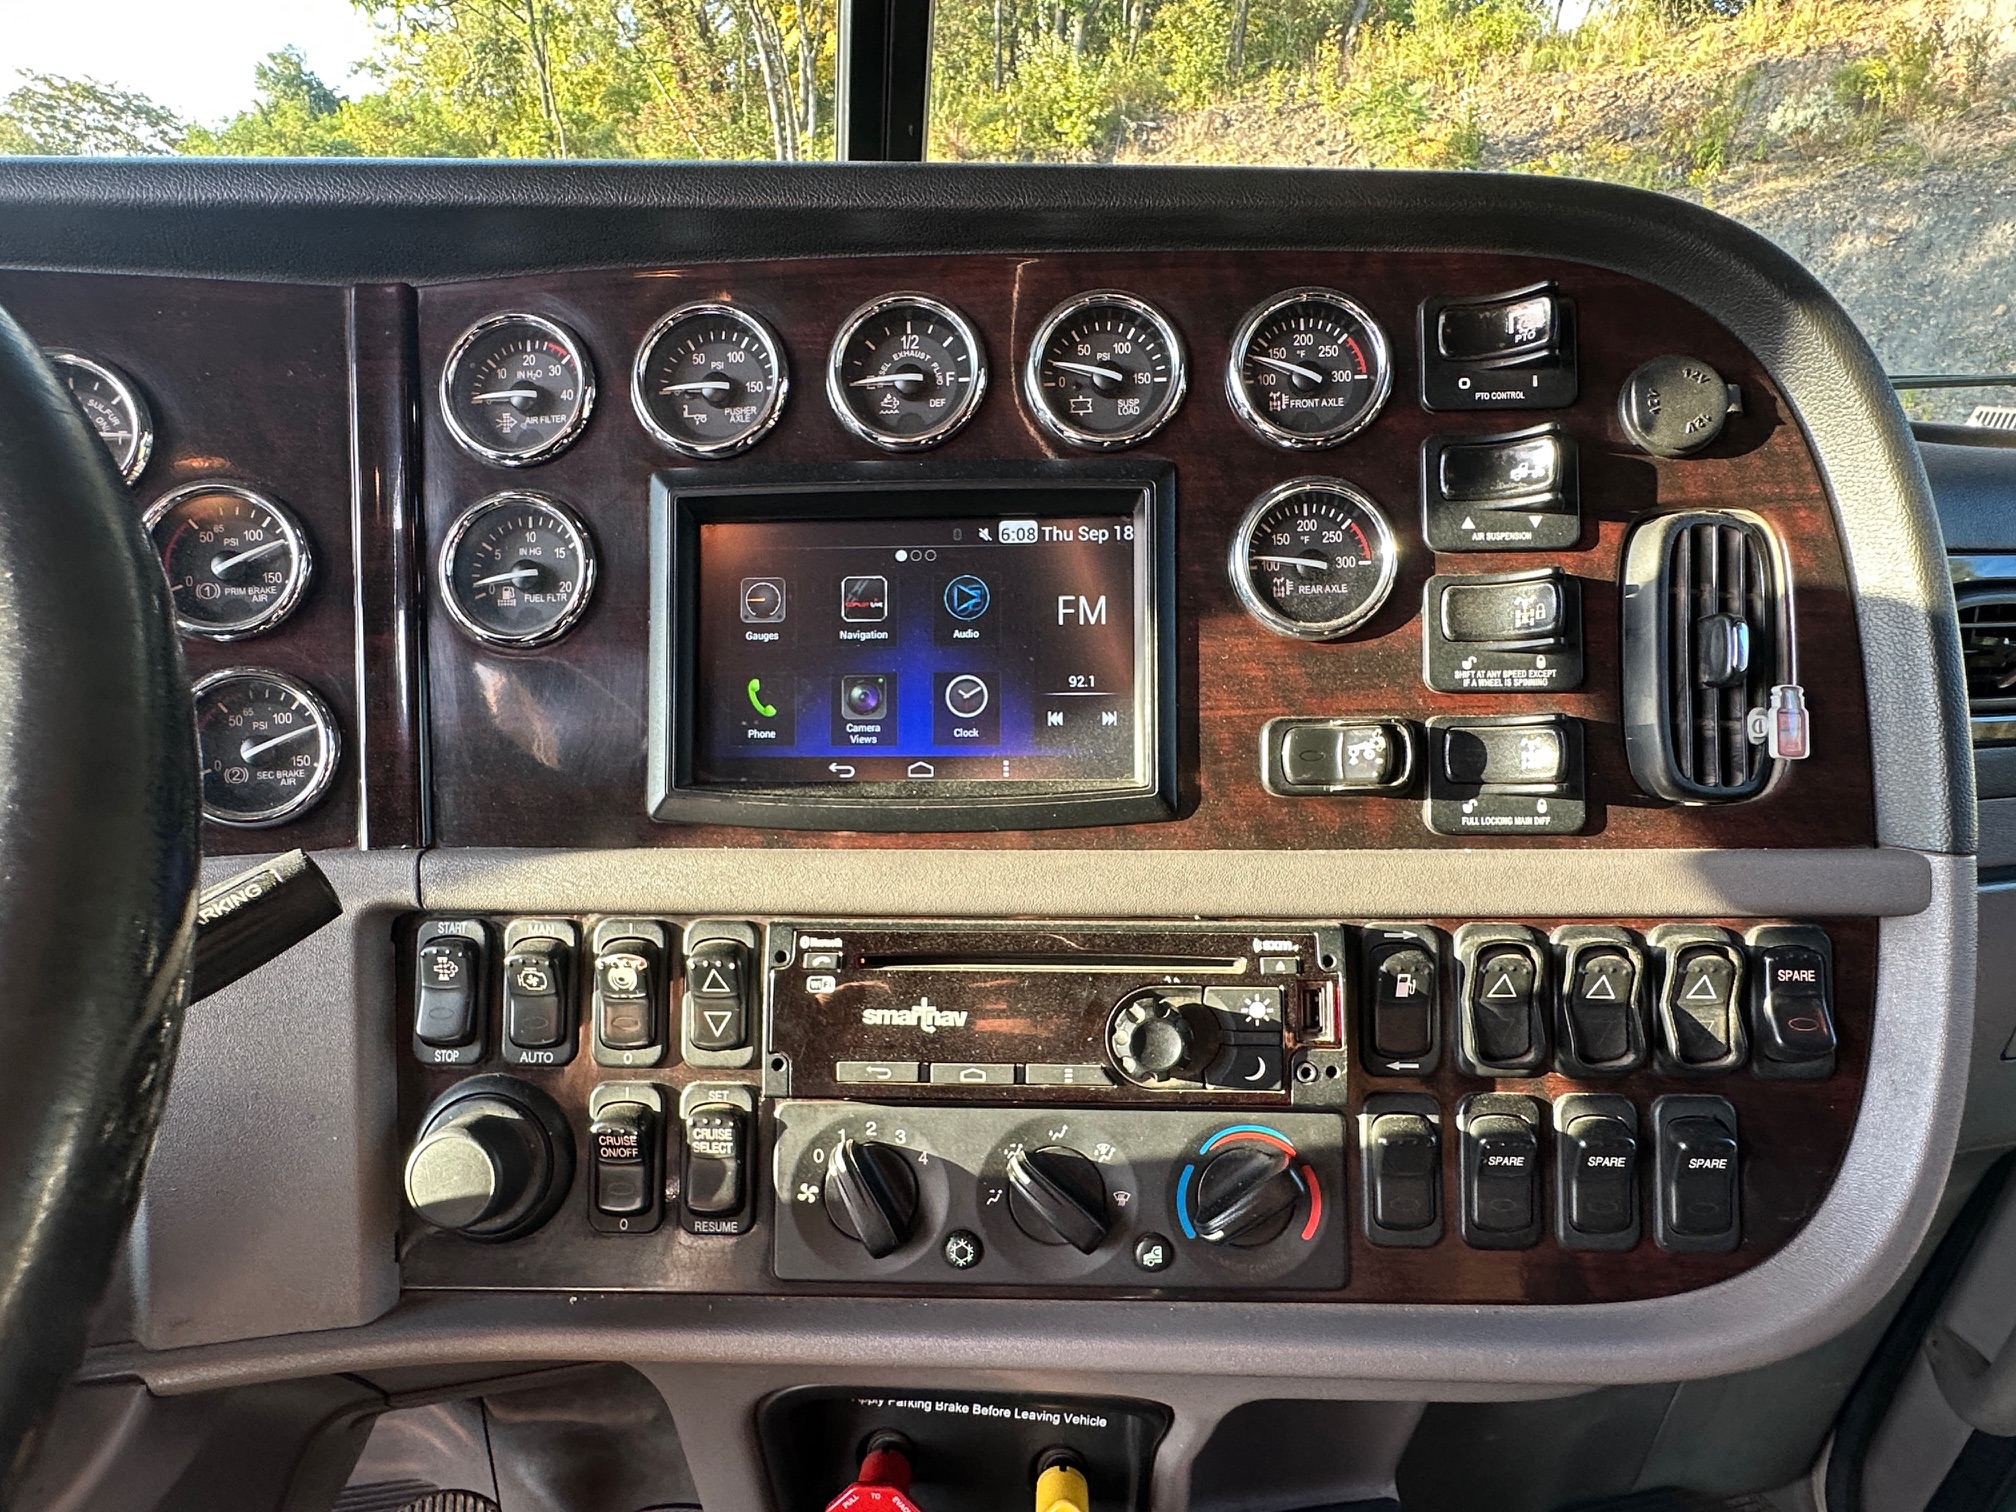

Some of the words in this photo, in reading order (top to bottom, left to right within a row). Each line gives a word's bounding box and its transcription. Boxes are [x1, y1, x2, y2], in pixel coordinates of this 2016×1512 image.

[1294, 334, 1313, 346] 200
[1515, 331, 1535, 342] PTO
[901, 335, 919, 349] 1/2
[1078, 344, 1090, 355] 50
[1113, 342, 1131, 354] 100
[1319, 346, 1338, 357] 250
[727, 352, 745, 362] 100
[892, 351, 931, 362] EXHAUST
[1268, 348, 1286, 359] 150
[523, 355, 535, 366] 20
[692, 354, 705, 364] 50
[549, 365, 561, 376] 30
[711, 362, 724, 370] PSI
[497, 369, 506, 379] 10
[517, 371, 526, 379] IN
[946, 372, 955, 386] F
[1133, 373, 1150, 384] 150
[1332, 371, 1351, 382] 300
[1059, 377, 1065, 387] 0
[1258, 374, 1276, 386] 100
[746, 382, 763, 392] 150
[561, 390, 573, 400] 40
[1476, 392, 1490, 400] PTO
[1492, 391, 1525, 399] CONTROL
[930, 399, 945, 407] DEF
[1118, 399, 1139, 407] SUSP
[1290, 399, 1319, 408] FRONT
[1321, 398, 1344, 406] AXLE
[88, 399, 120, 426] SULFUR
[725, 406, 756, 414] PUSHER
[1118, 406, 1140, 415] LOAD
[540, 415, 566, 423] FILTER
[729, 414, 750, 422] AXLE
[1297, 519, 1317, 531] 200
[200, 531, 213, 542] 50
[244, 530, 262, 542] 100
[526, 532, 536, 542] 10
[1001, 530, 1036, 540] 6:08
[1042, 527, 1073, 541] Thu
[1078, 527, 1109, 544] Sep
[1114, 526, 1134, 540] 18
[1272, 534, 1290, 544] 150
[1322, 531, 1342, 543] 250
[1472, 532, 1484, 540] AIR
[1486, 532, 1531, 540] SUSPENSION
[224, 538, 238, 546] PSI
[495, 550, 501, 560] 5
[529, 547, 541, 555] HG
[554, 548, 565, 558] 15
[1262, 562, 1280, 571] 100
[1336, 556, 1355, 568] 300
[185, 576, 193, 586] 0
[262, 572, 282, 583] 150
[248, 586, 276, 594] BRAKE
[489, 584, 495, 594] 0
[559, 582, 571, 592] 20
[1299, 585, 1322, 594] REAR
[1325, 584, 1347, 593] AXLE
[525, 594, 545, 602] FUEL
[547, 594, 567, 602] FLTR
[1058, 595, 1106, 625] FM
[746, 631, 779, 642] Gauges
[840, 630, 888, 641] Navigation
[953, 630, 979, 639] Audio
[1454, 670, 1476, 678] SHIFT
[1477, 670, 1486, 678] AT
[1486, 670, 1502, 678] ANY
[1503, 670, 1527, 678] SPEED
[1529, 669, 1557, 678] EXCEPT
[1069, 676, 1095, 687] 92.1
[1463, 679, 1470, 687] IF
[1478, 679, 1503, 687] WHEEL
[243, 708, 253, 716] 65
[229, 715, 242, 726] 50
[273, 713, 292, 724] 100
[253, 722, 268, 730] PSI
[846, 723, 880, 733] Camera
[748, 729, 776, 738] Phone
[954, 728, 978, 737] Clock
[850, 735, 877, 744] Views
[215, 760, 221, 770] 0
[291, 755, 310, 766] 150
[276, 770, 305, 778] BRAKE
[281, 778, 296, 786] AIR
[1462, 817, 1479, 826] FULL
[1481, 817, 1512, 826] LOCKING
[1514, 817, 1532, 826] MAIN
[1534, 816, 1550, 826] DIFF
[198, 884, 262, 925] RKING
[438, 922, 467, 934] START
[528, 925, 554, 935] MAN
[1778, 970, 1816, 982] SPARE
[435, 1050, 459, 1062] STOP
[520, 1052, 553, 1063] AUTO
[709, 1091, 729, 1101] SET
[693, 1128, 732, 1140] CRUISE
[866, 1122, 877, 1136] 2
[599, 1135, 638, 1146] CRUISE
[838, 1129, 846, 1143] 1
[895, 1130, 906, 1144] 3
[601, 1148, 638, 1158] ON/OFF
[693, 1142, 733, 1154] SELECT
[814, 1148, 824, 1163] 0
[918, 1151, 928, 1165] 4
[1488, 1156, 1524, 1167] SPARE
[1588, 1156, 1625, 1168] SPARE
[1688, 1158, 1727, 1170] SPARE
[695, 1221, 738, 1232] RESUME
[888, 1399, 932, 1412] Parking
[935, 1400, 970, 1414] Brake
[973, 1404, 1011, 1418] Before
[1014, 1407, 1060, 1426] Leaving
[1064, 1413, 1107, 1428] Vehicle
[871, 1492, 881, 1500] TO
